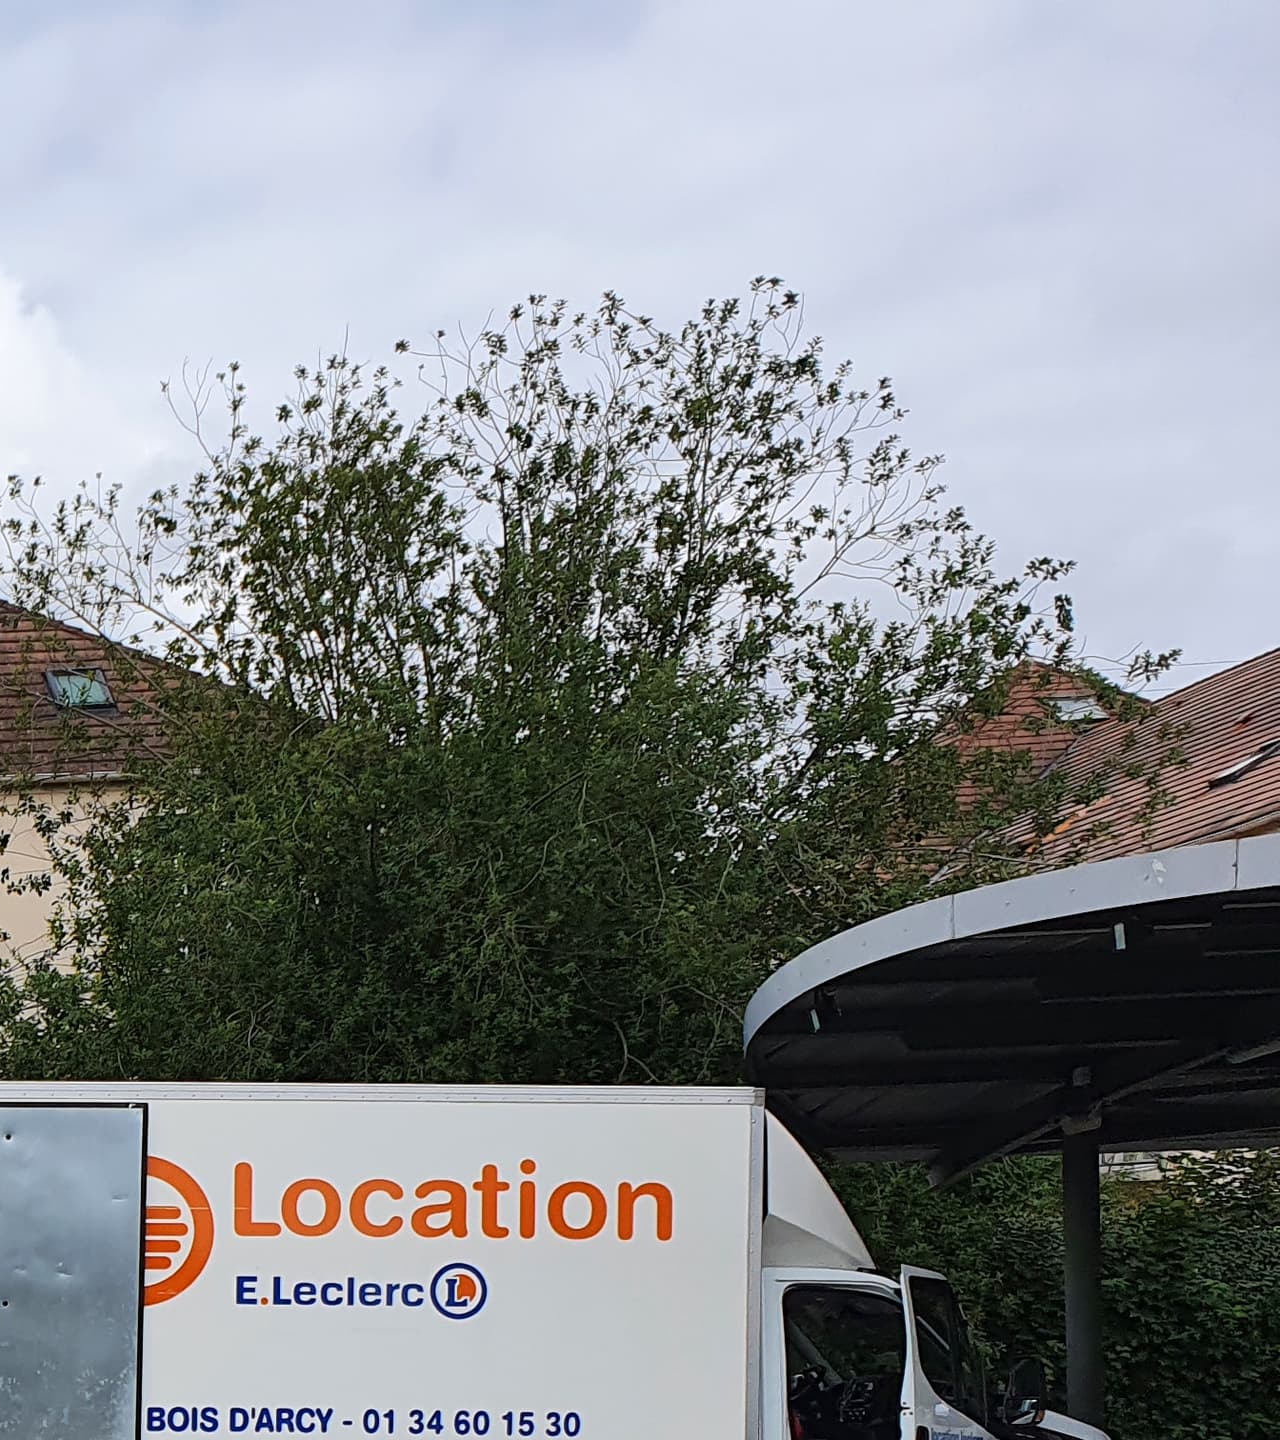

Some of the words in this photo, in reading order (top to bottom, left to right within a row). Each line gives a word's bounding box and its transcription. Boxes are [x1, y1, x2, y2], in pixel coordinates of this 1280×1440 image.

[234, 1159, 673, 1241] Location
[235, 1276, 425, 1306] E.Leclerc
[146, 1407, 219, 1433] BOIS
[228, 1407, 333, 1433] D'ARCY
[362, 1409, 395, 1434] 01
[407, 1409, 443, 1435] 34
[453, 1410, 490, 1436] 60
[501, 1411, 535, 1436] 15
[545, 1411, 581, 1437] 30
